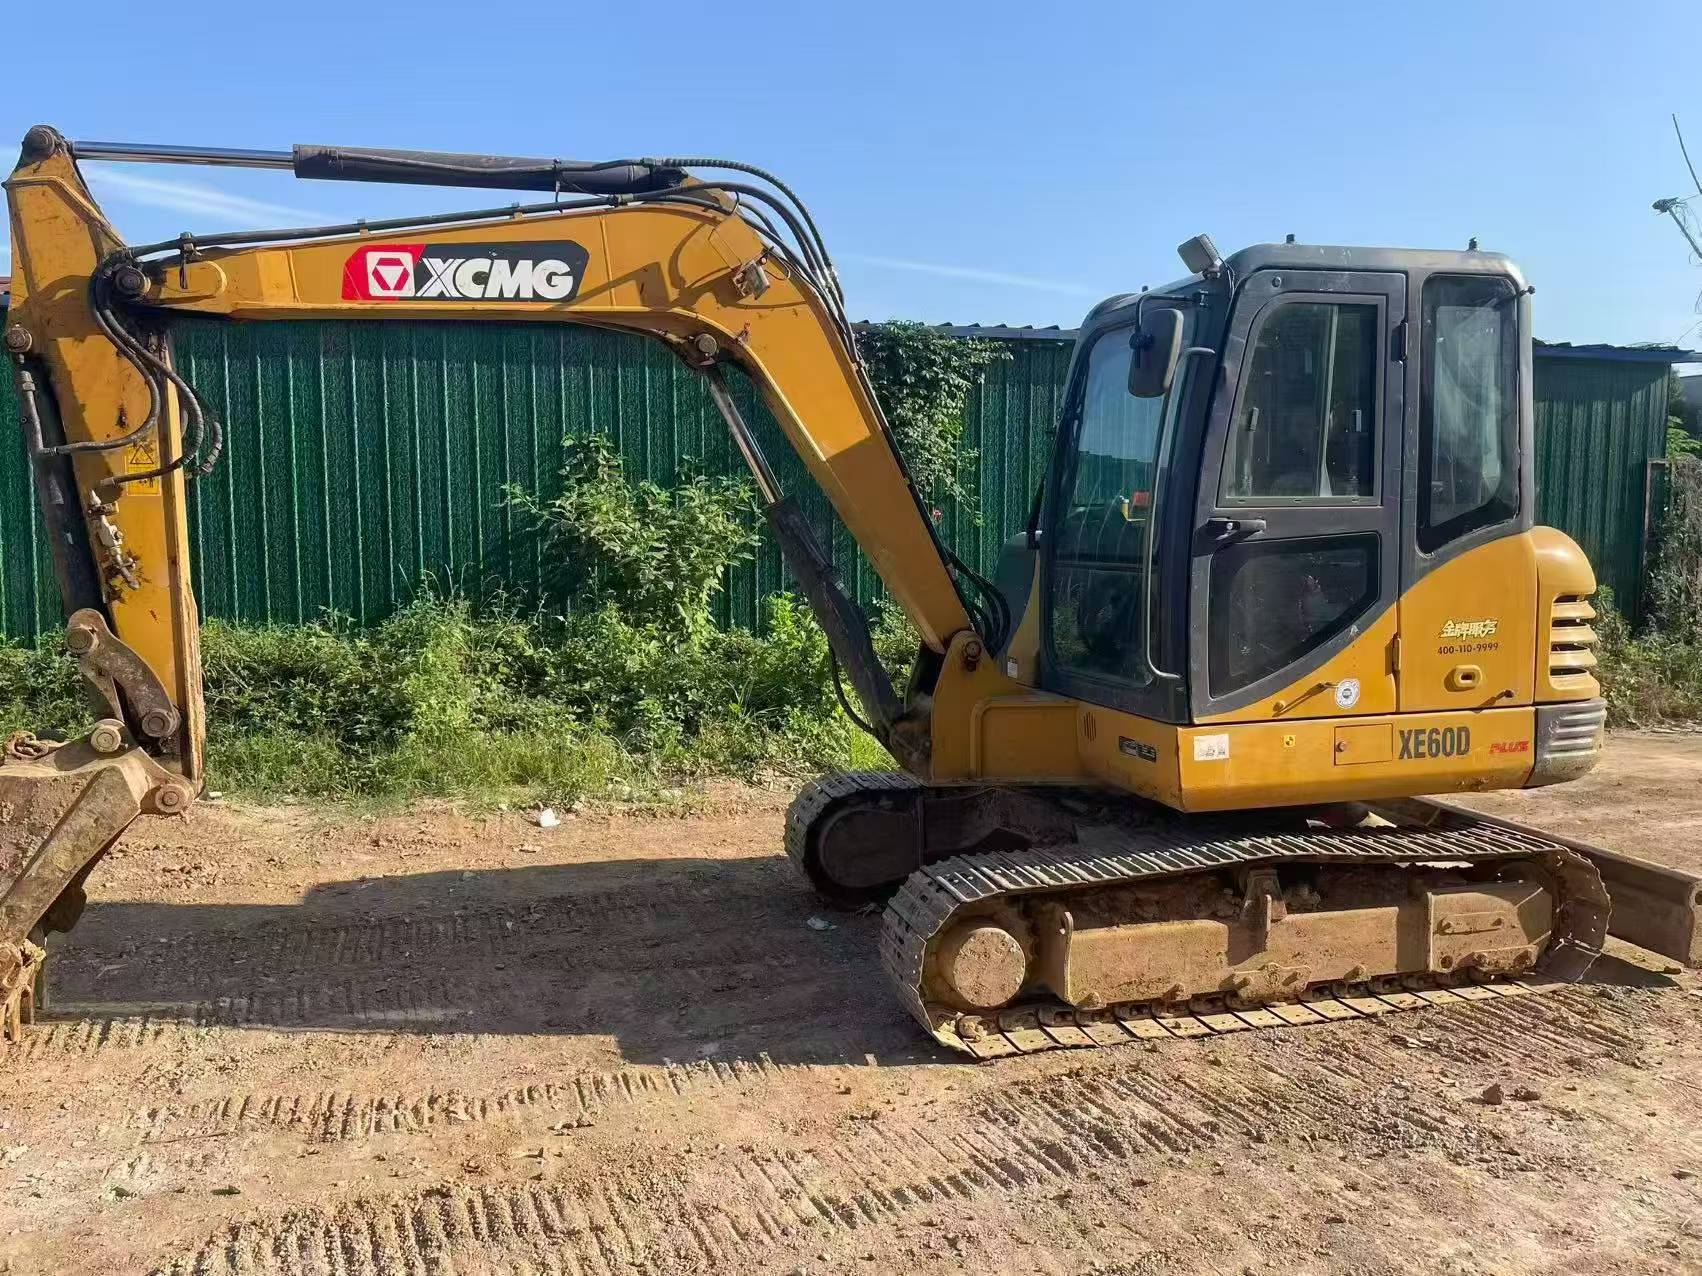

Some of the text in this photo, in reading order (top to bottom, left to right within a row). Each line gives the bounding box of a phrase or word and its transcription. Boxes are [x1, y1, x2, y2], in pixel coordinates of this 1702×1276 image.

[415, 257, 574, 299] XCMG
[1438, 642, 1499, 655] 400-110-9999
[1399, 726, 1471, 760] XE60D
[1489, 740, 1529, 754] PLUS
